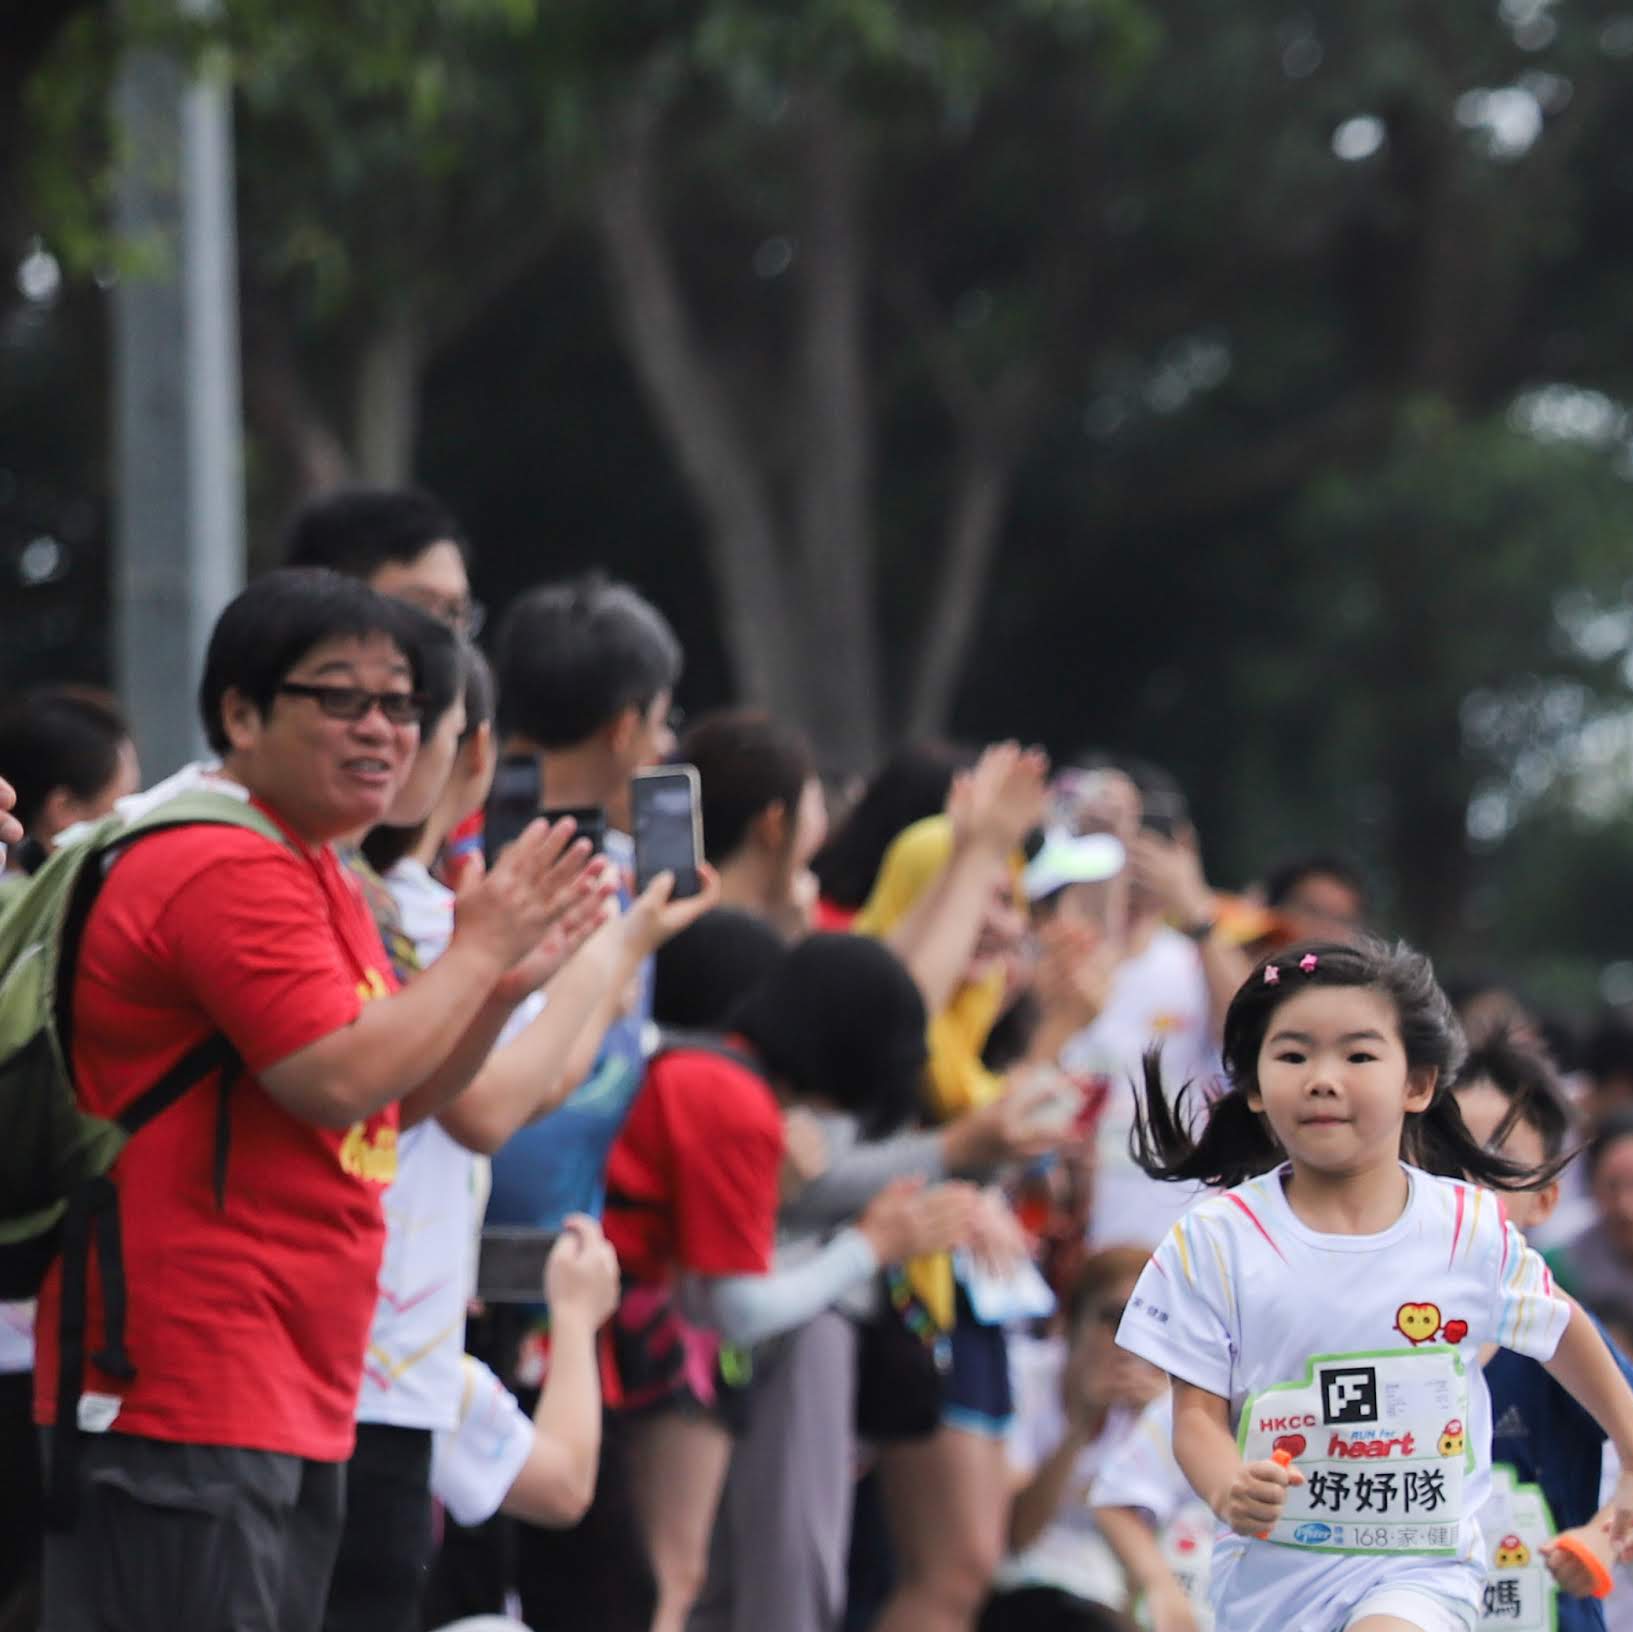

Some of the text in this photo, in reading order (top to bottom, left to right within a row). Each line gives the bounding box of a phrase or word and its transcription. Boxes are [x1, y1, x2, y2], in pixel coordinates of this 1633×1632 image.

[1260, 1415, 1316, 1432] HKCC
[1351, 1430, 1375, 1440] RUN
[1327, 1431, 1416, 1459] heart
